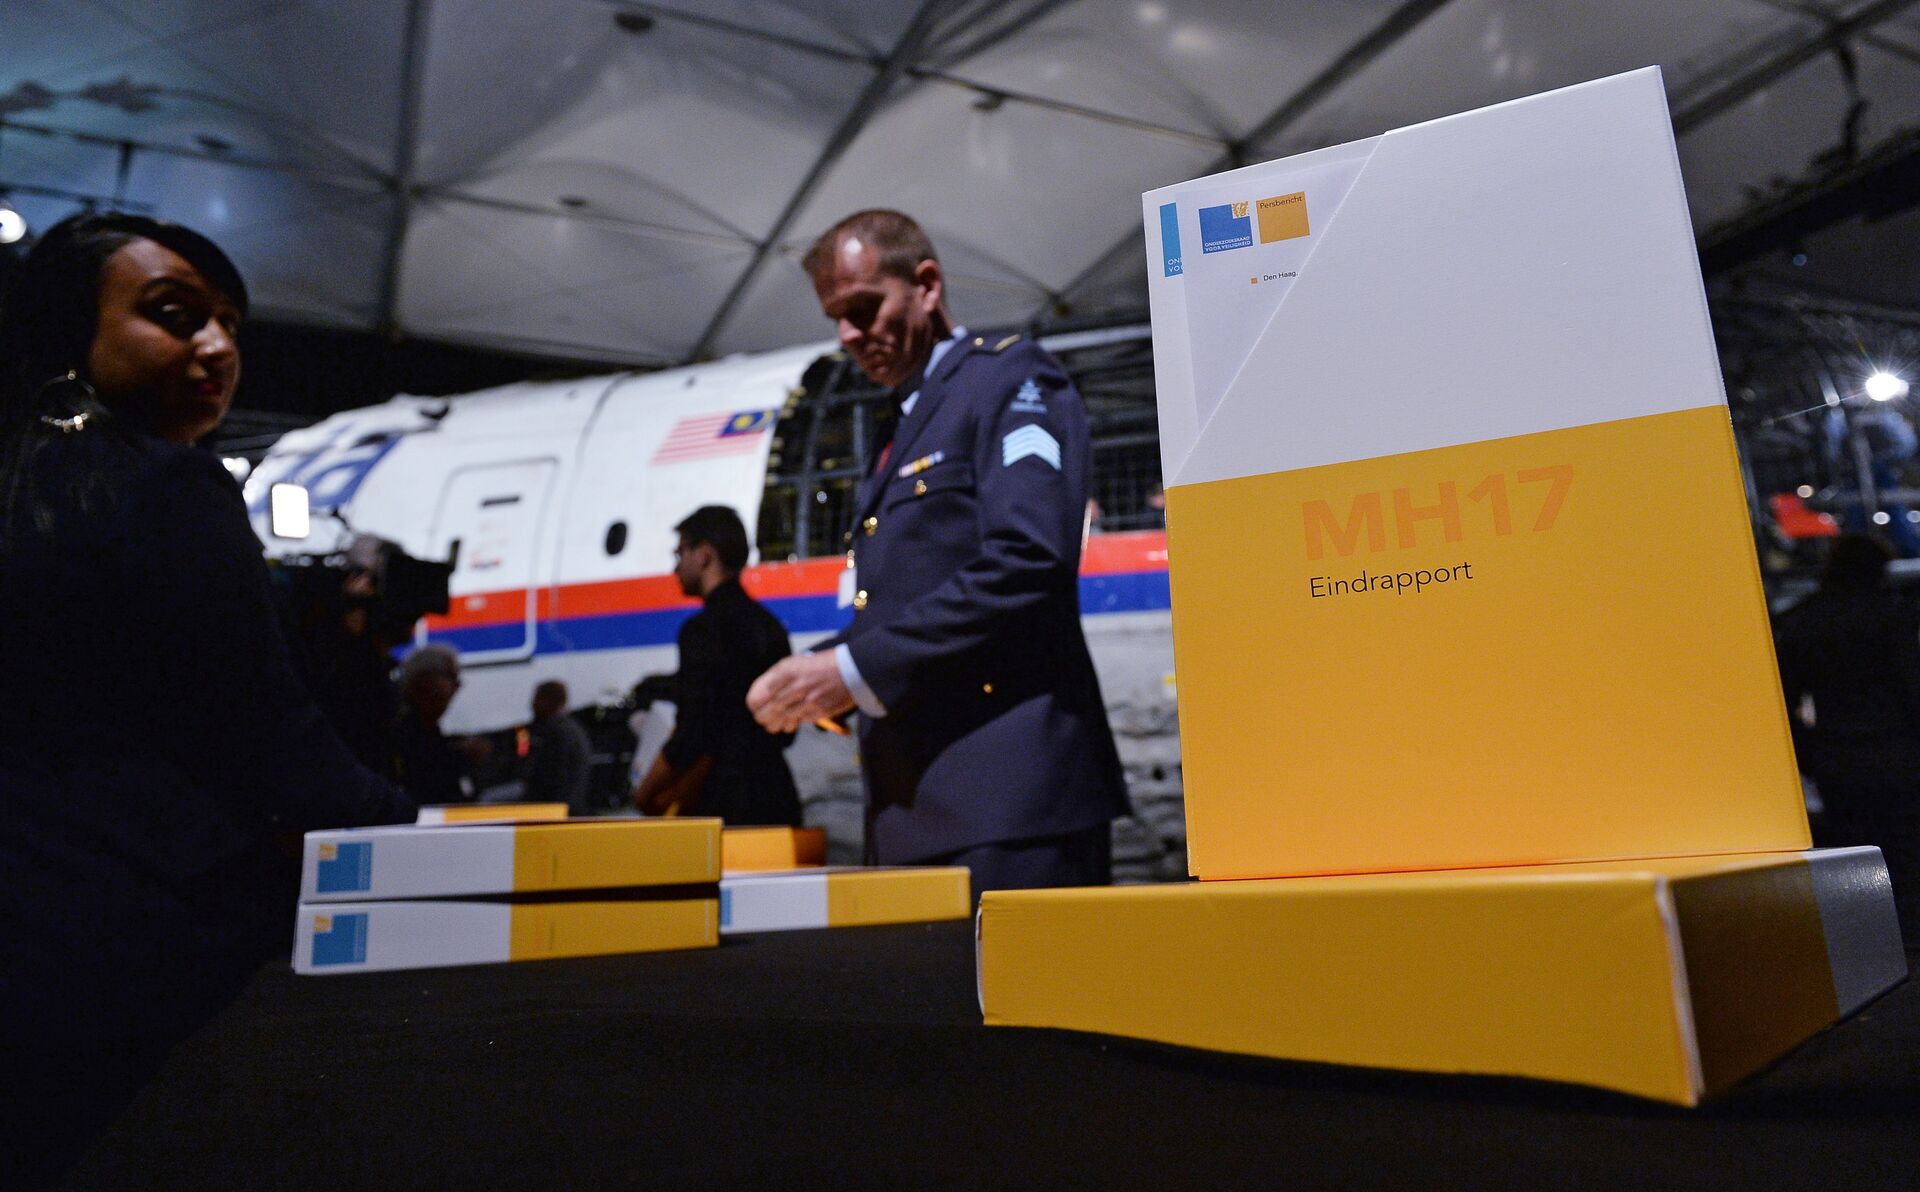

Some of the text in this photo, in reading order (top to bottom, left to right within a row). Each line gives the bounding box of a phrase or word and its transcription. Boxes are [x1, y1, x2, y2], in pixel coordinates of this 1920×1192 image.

[1260, 196, 1303, 210] Persbericht
[1263, 274, 1278, 282] Den
[1302, 464, 1574, 561] MH17
[1310, 561, 1473, 598] Eindrapport
